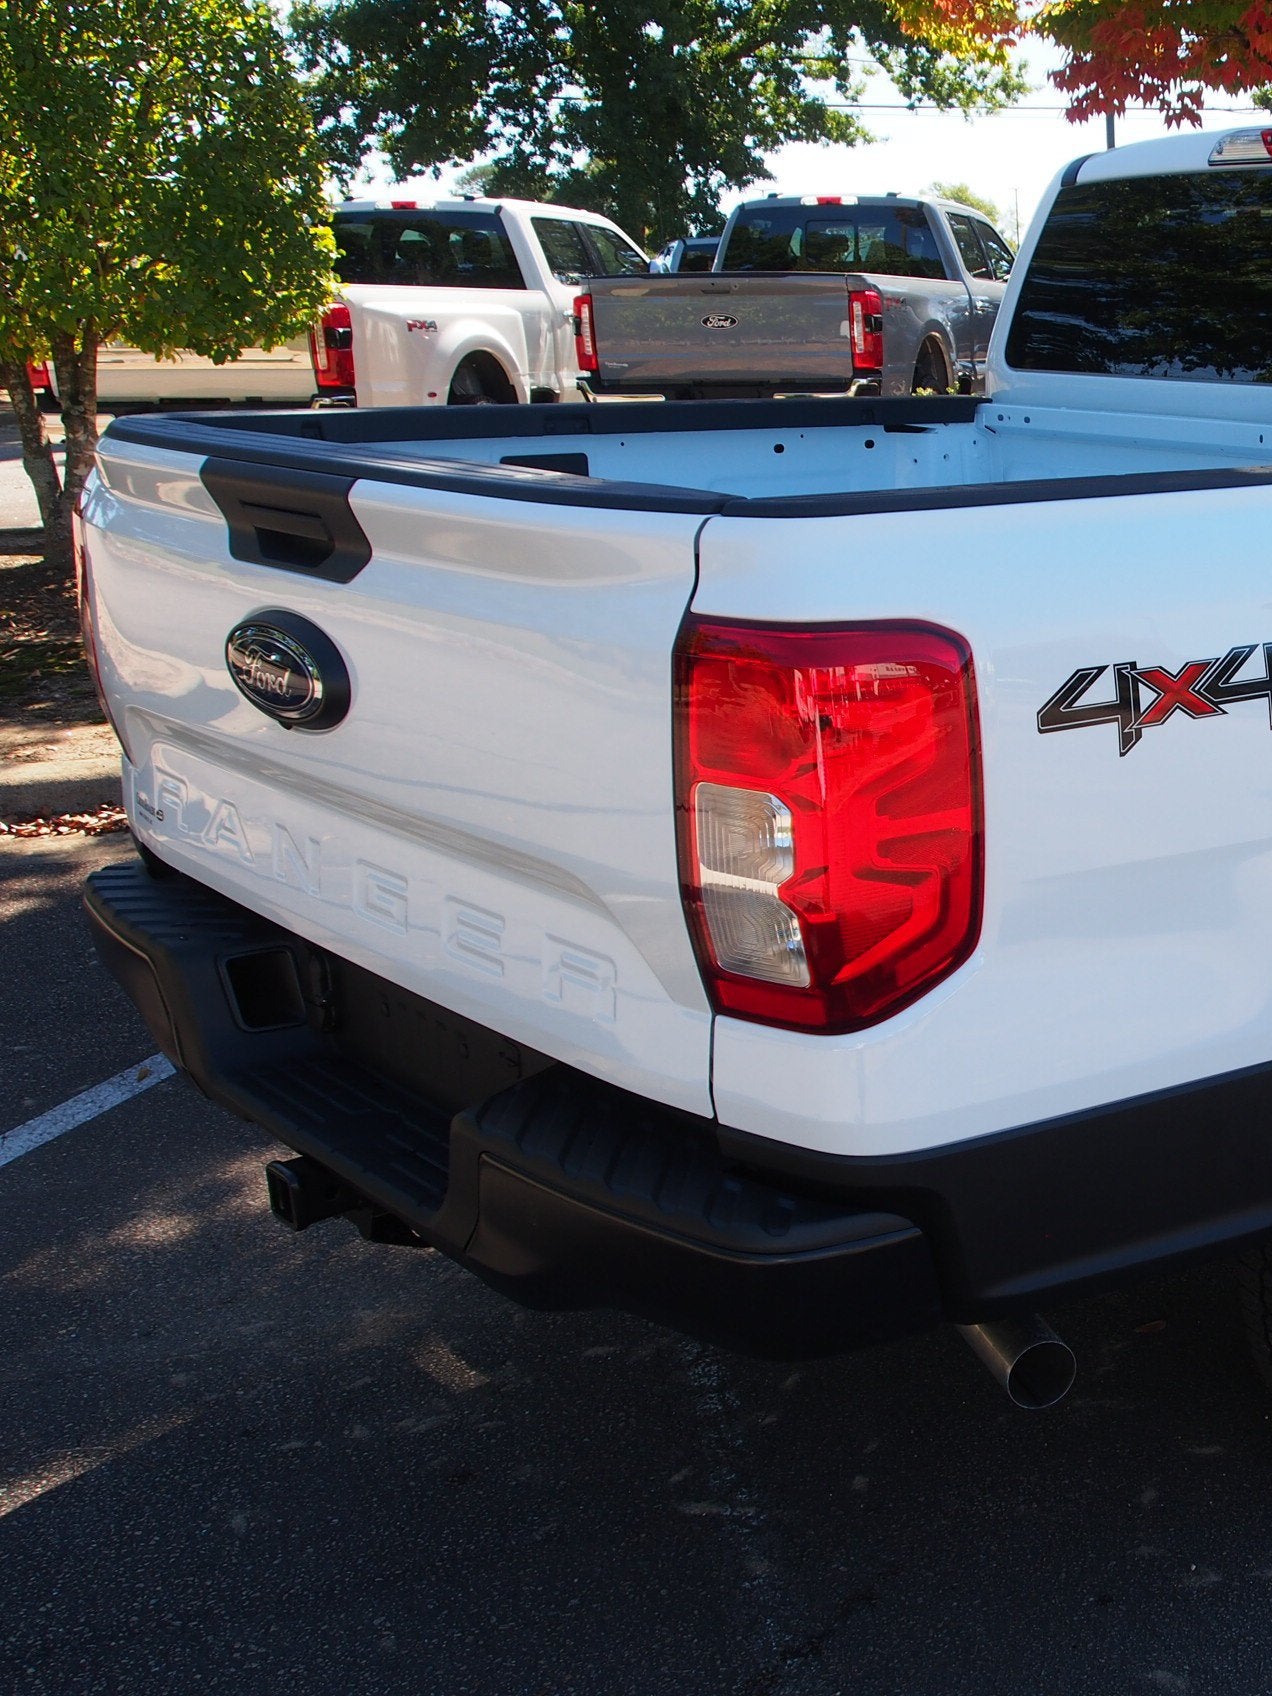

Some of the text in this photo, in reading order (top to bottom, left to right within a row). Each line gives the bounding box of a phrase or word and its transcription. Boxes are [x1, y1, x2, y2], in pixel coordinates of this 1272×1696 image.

[707, 315, 732, 327] Ford
[238, 645, 292, 698] Ford
[152, 764, 619, 1025] RANGER
